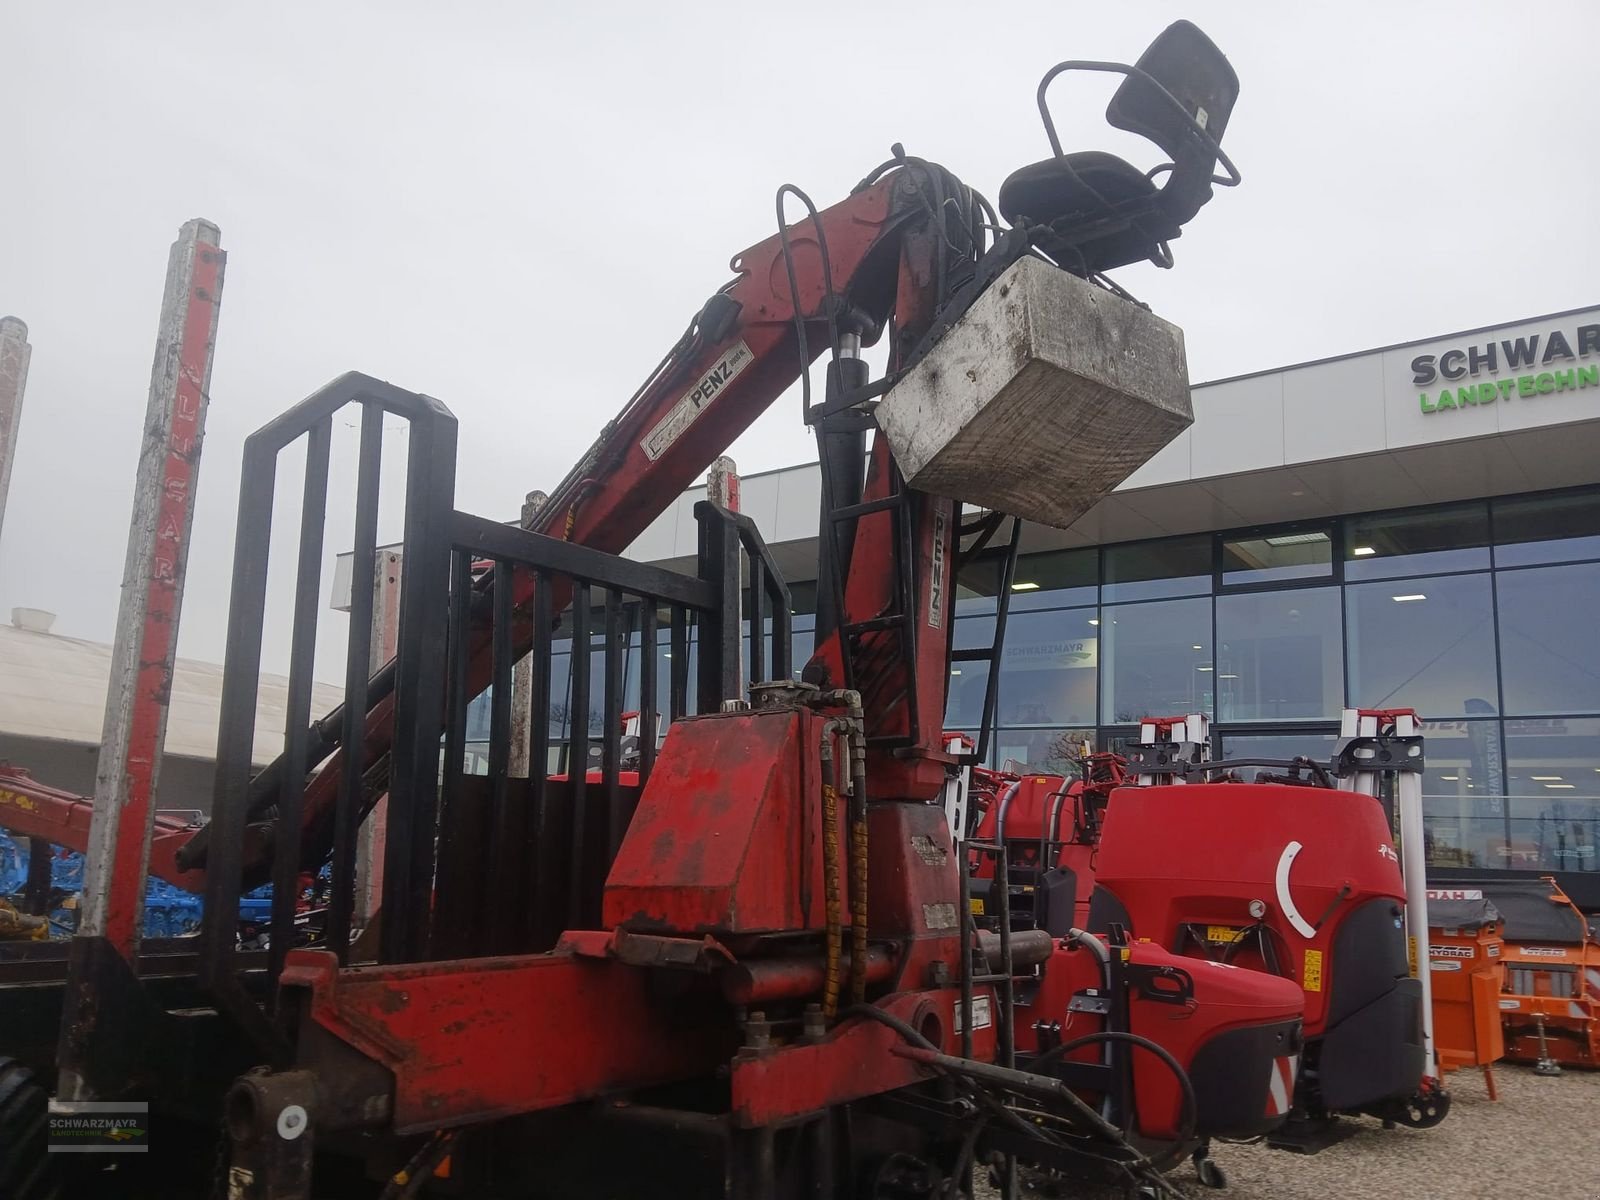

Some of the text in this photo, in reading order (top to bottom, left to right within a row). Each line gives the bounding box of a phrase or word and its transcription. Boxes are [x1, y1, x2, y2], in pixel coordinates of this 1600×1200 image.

[1410, 323, 1600, 385] SCHWAR
[690, 361, 733, 409] PENZ
[931, 516, 944, 610] PENZ
[1428, 949, 1472, 958] HYDRAC
